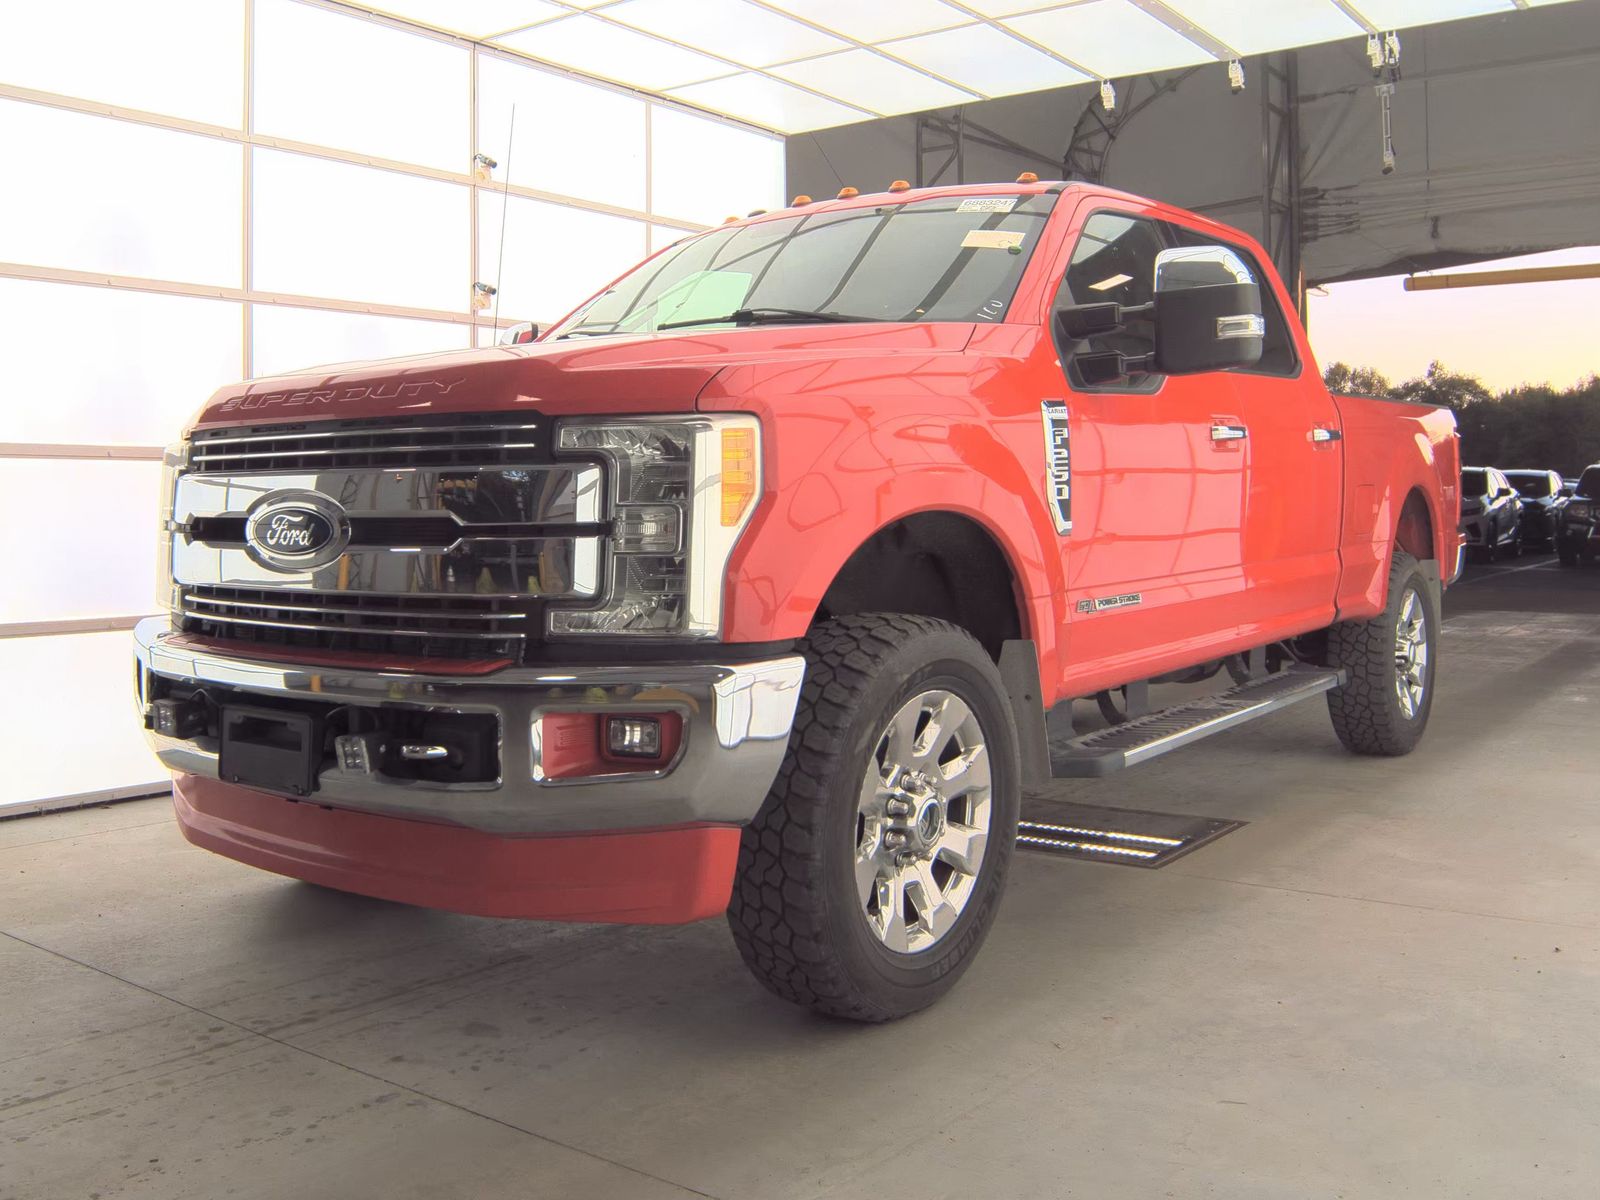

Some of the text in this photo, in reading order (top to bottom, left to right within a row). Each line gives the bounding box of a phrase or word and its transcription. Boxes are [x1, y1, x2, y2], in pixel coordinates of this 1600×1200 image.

[219, 378, 467, 411] SUPER DUTY
[266, 514, 316, 546] Ford
